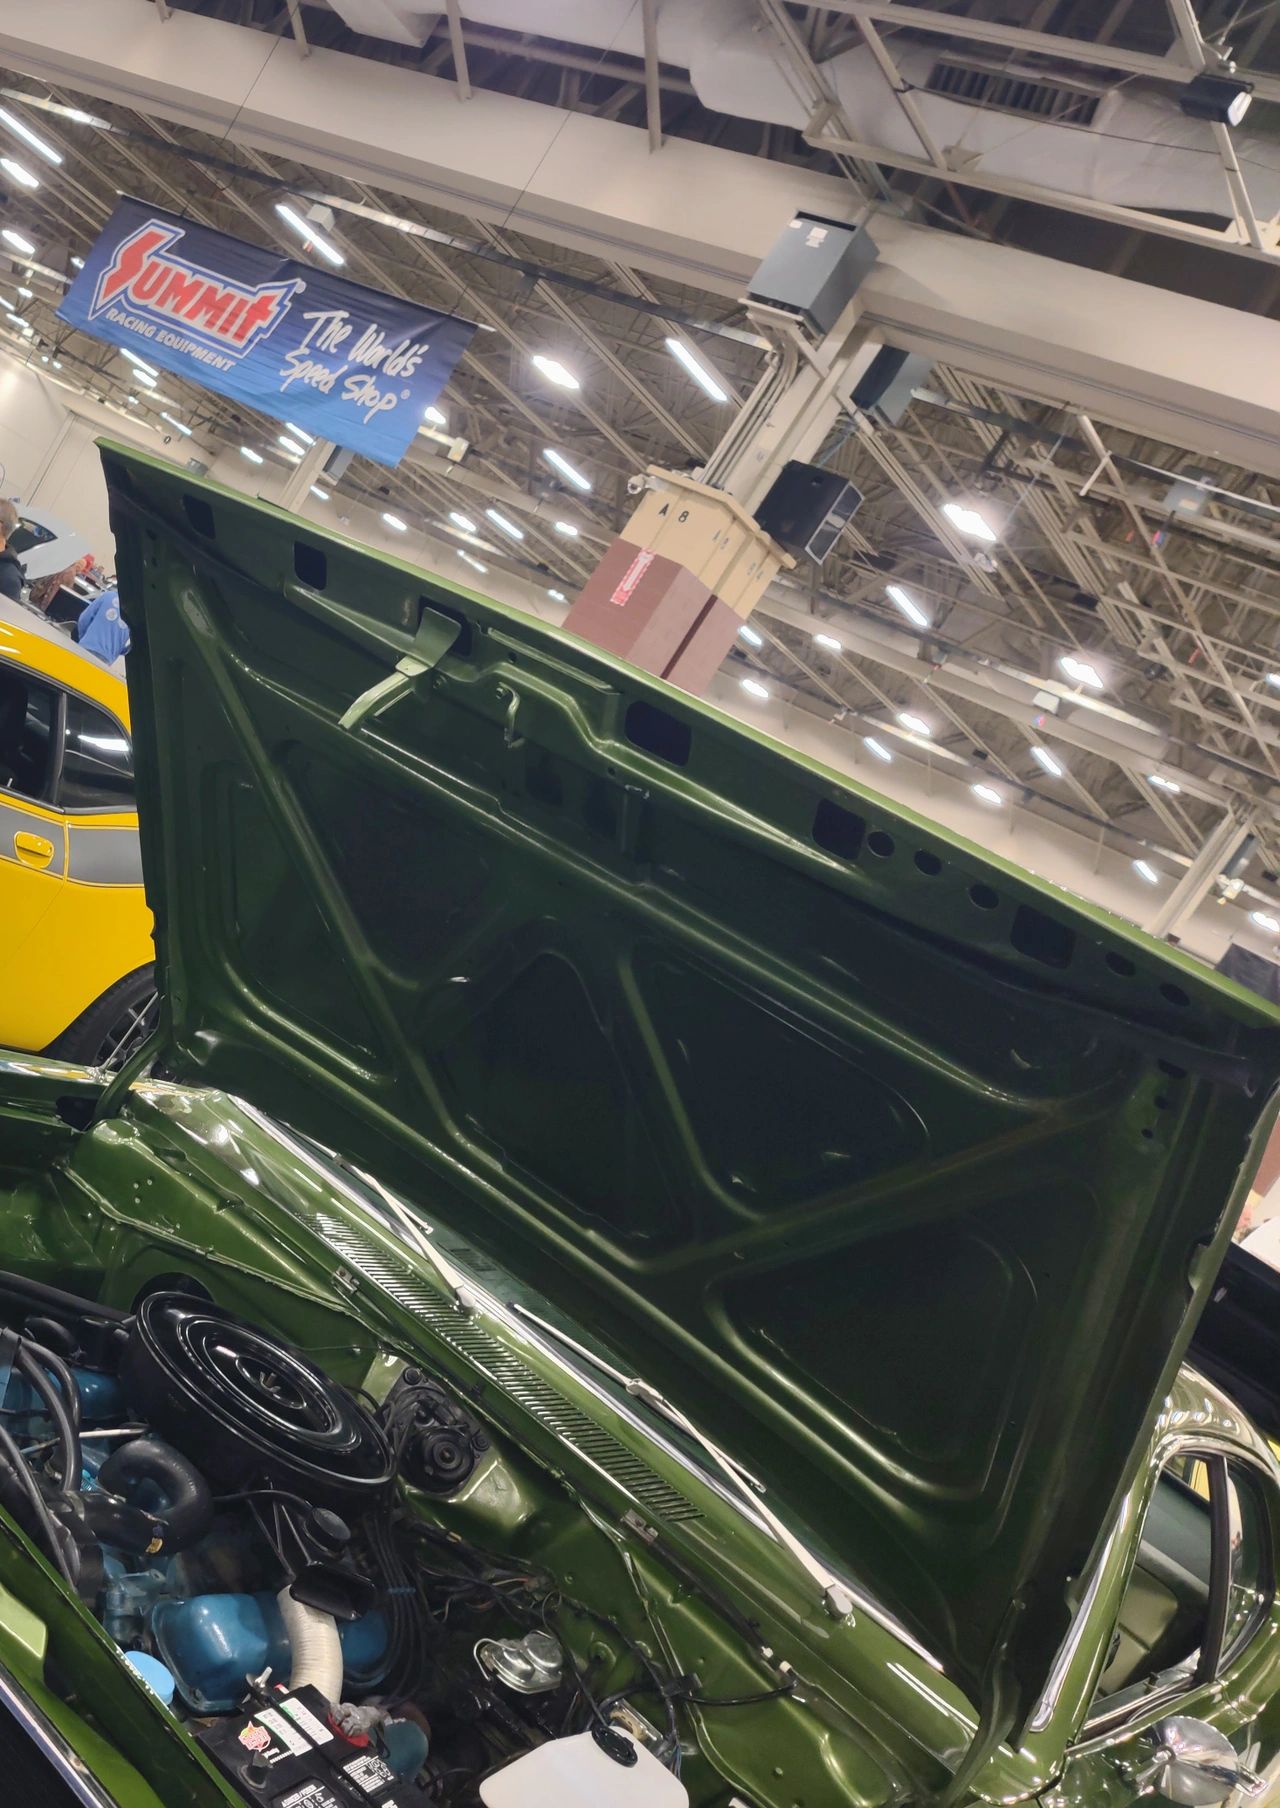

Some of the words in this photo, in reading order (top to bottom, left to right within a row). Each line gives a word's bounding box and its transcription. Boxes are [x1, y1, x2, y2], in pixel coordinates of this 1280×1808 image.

[106, 307, 158, 338] RACING
[154, 329, 237, 372] EQUIPMENT
[302, 310, 353, 353] The
[347, 323, 429, 377] World's
[279, 347, 348, 393] Speed
[658, 503, 669, 516] A
[678, 510, 689, 523] 8
